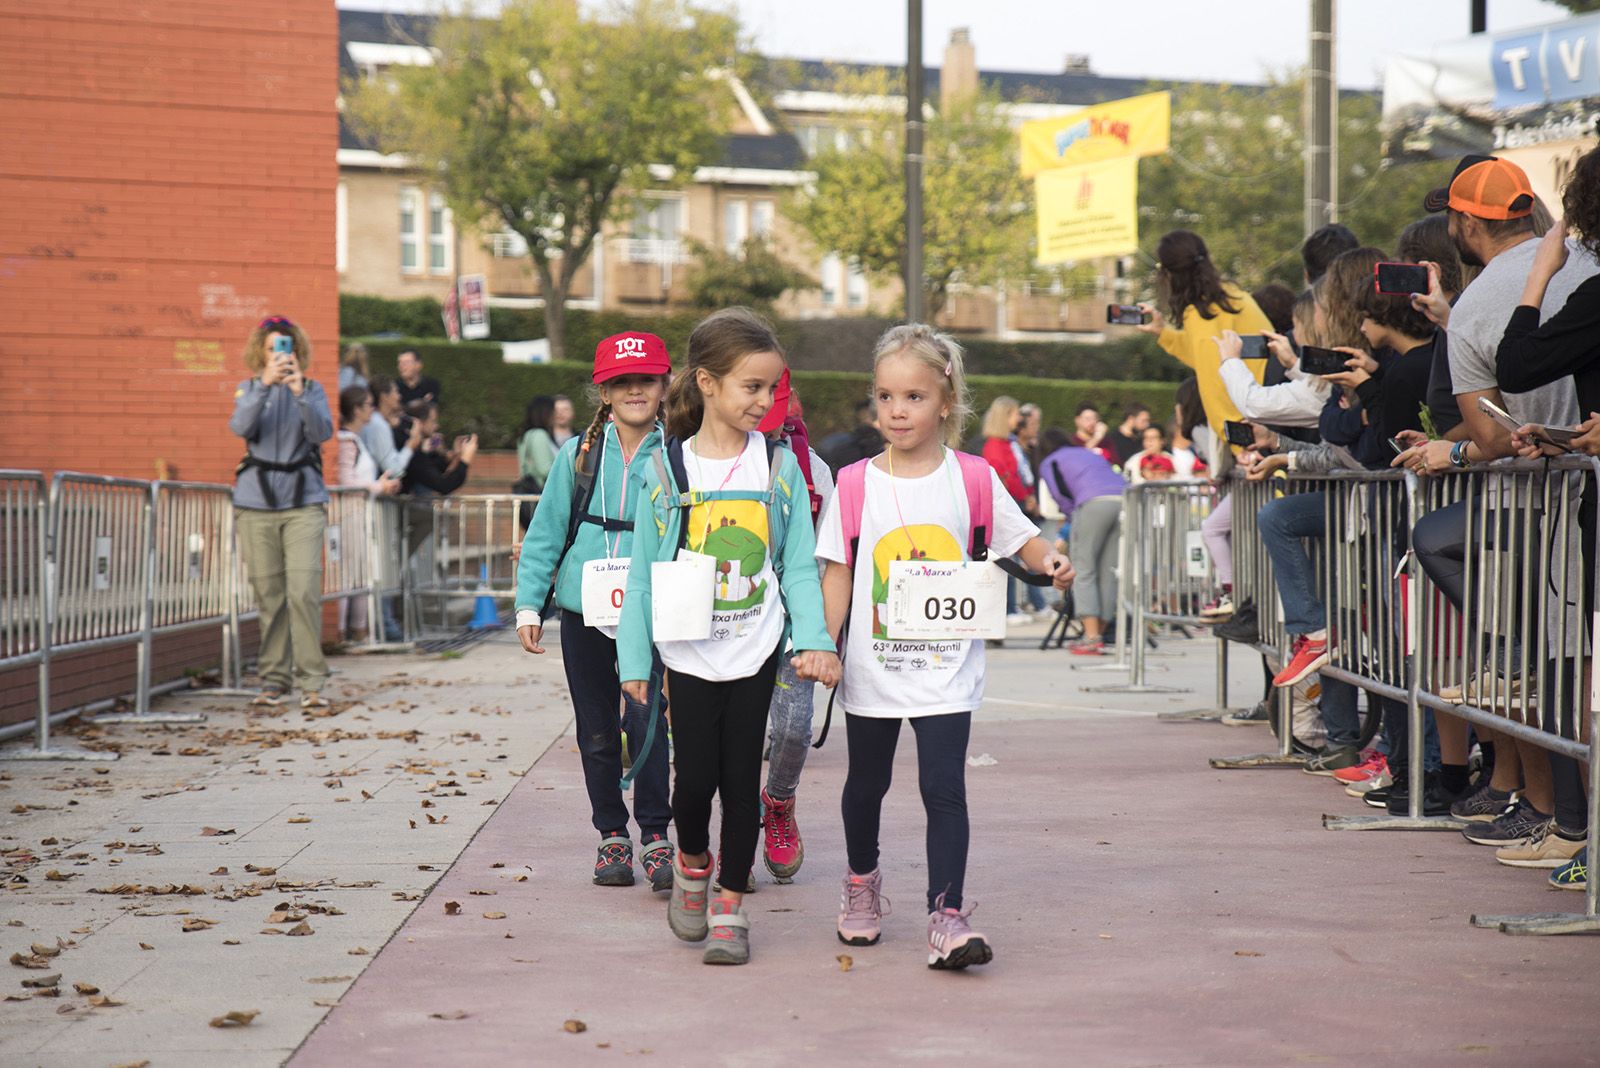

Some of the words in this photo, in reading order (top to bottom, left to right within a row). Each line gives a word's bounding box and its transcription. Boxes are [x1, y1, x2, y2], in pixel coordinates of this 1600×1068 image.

[615, 337, 645, 352] TOT
[732, 605, 762, 621] Infantil
[924, 597, 976, 620] 030
[891, 642, 926, 653] Marxa
[928, 641, 961, 653] Infantil
